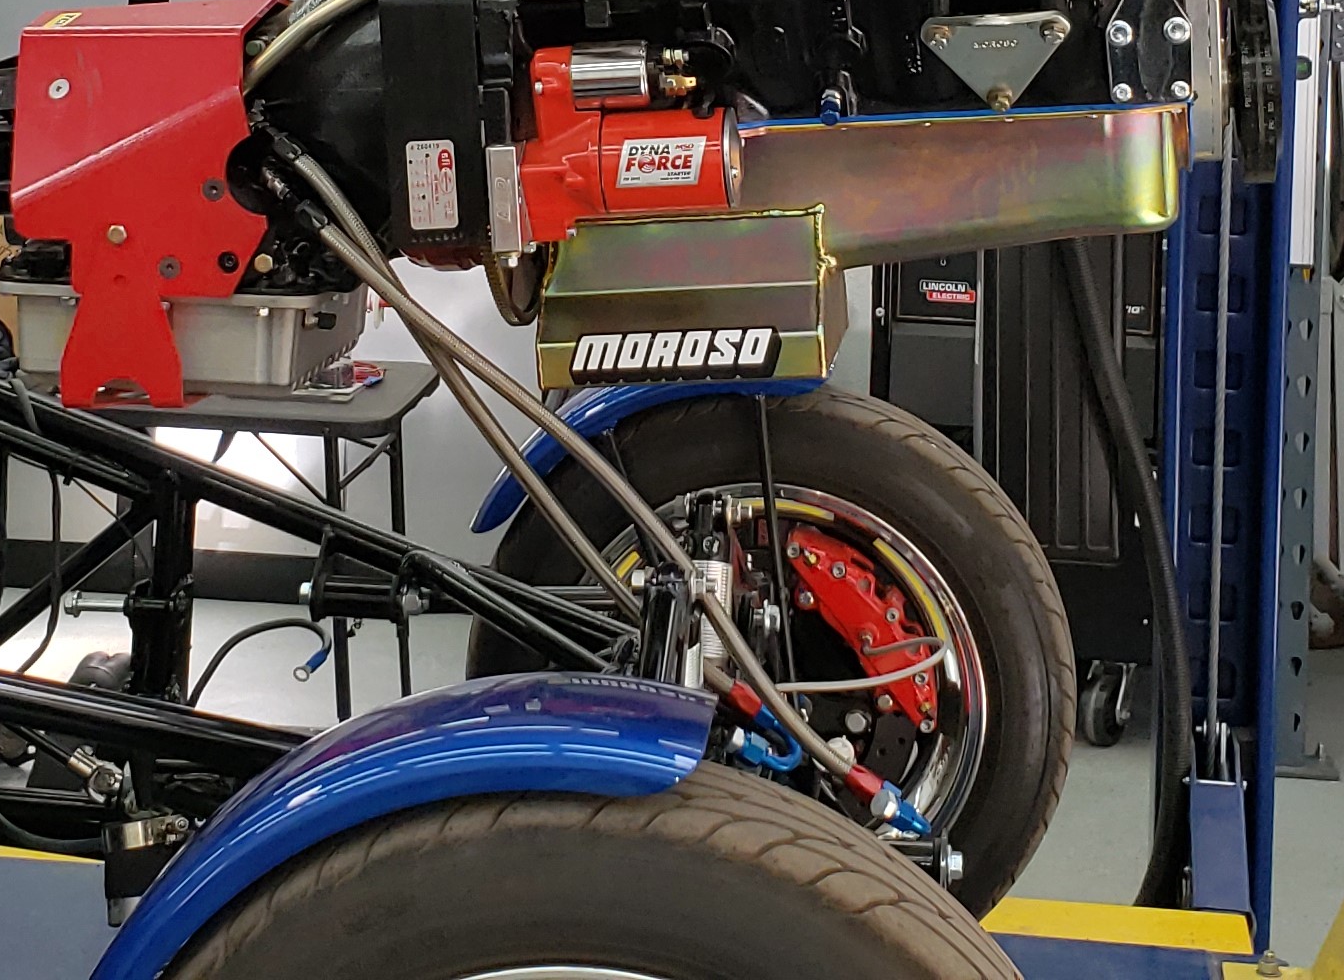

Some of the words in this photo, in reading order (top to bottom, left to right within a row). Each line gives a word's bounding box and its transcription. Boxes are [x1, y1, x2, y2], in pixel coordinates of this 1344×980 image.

[628, 143, 671, 157] DYNA
[624, 154, 694, 174] FORCE
[922, 282, 967, 293] LINCOLN
[931, 292, 972, 301] ELECTRIC
[571, 328, 774, 372] MOROSO
